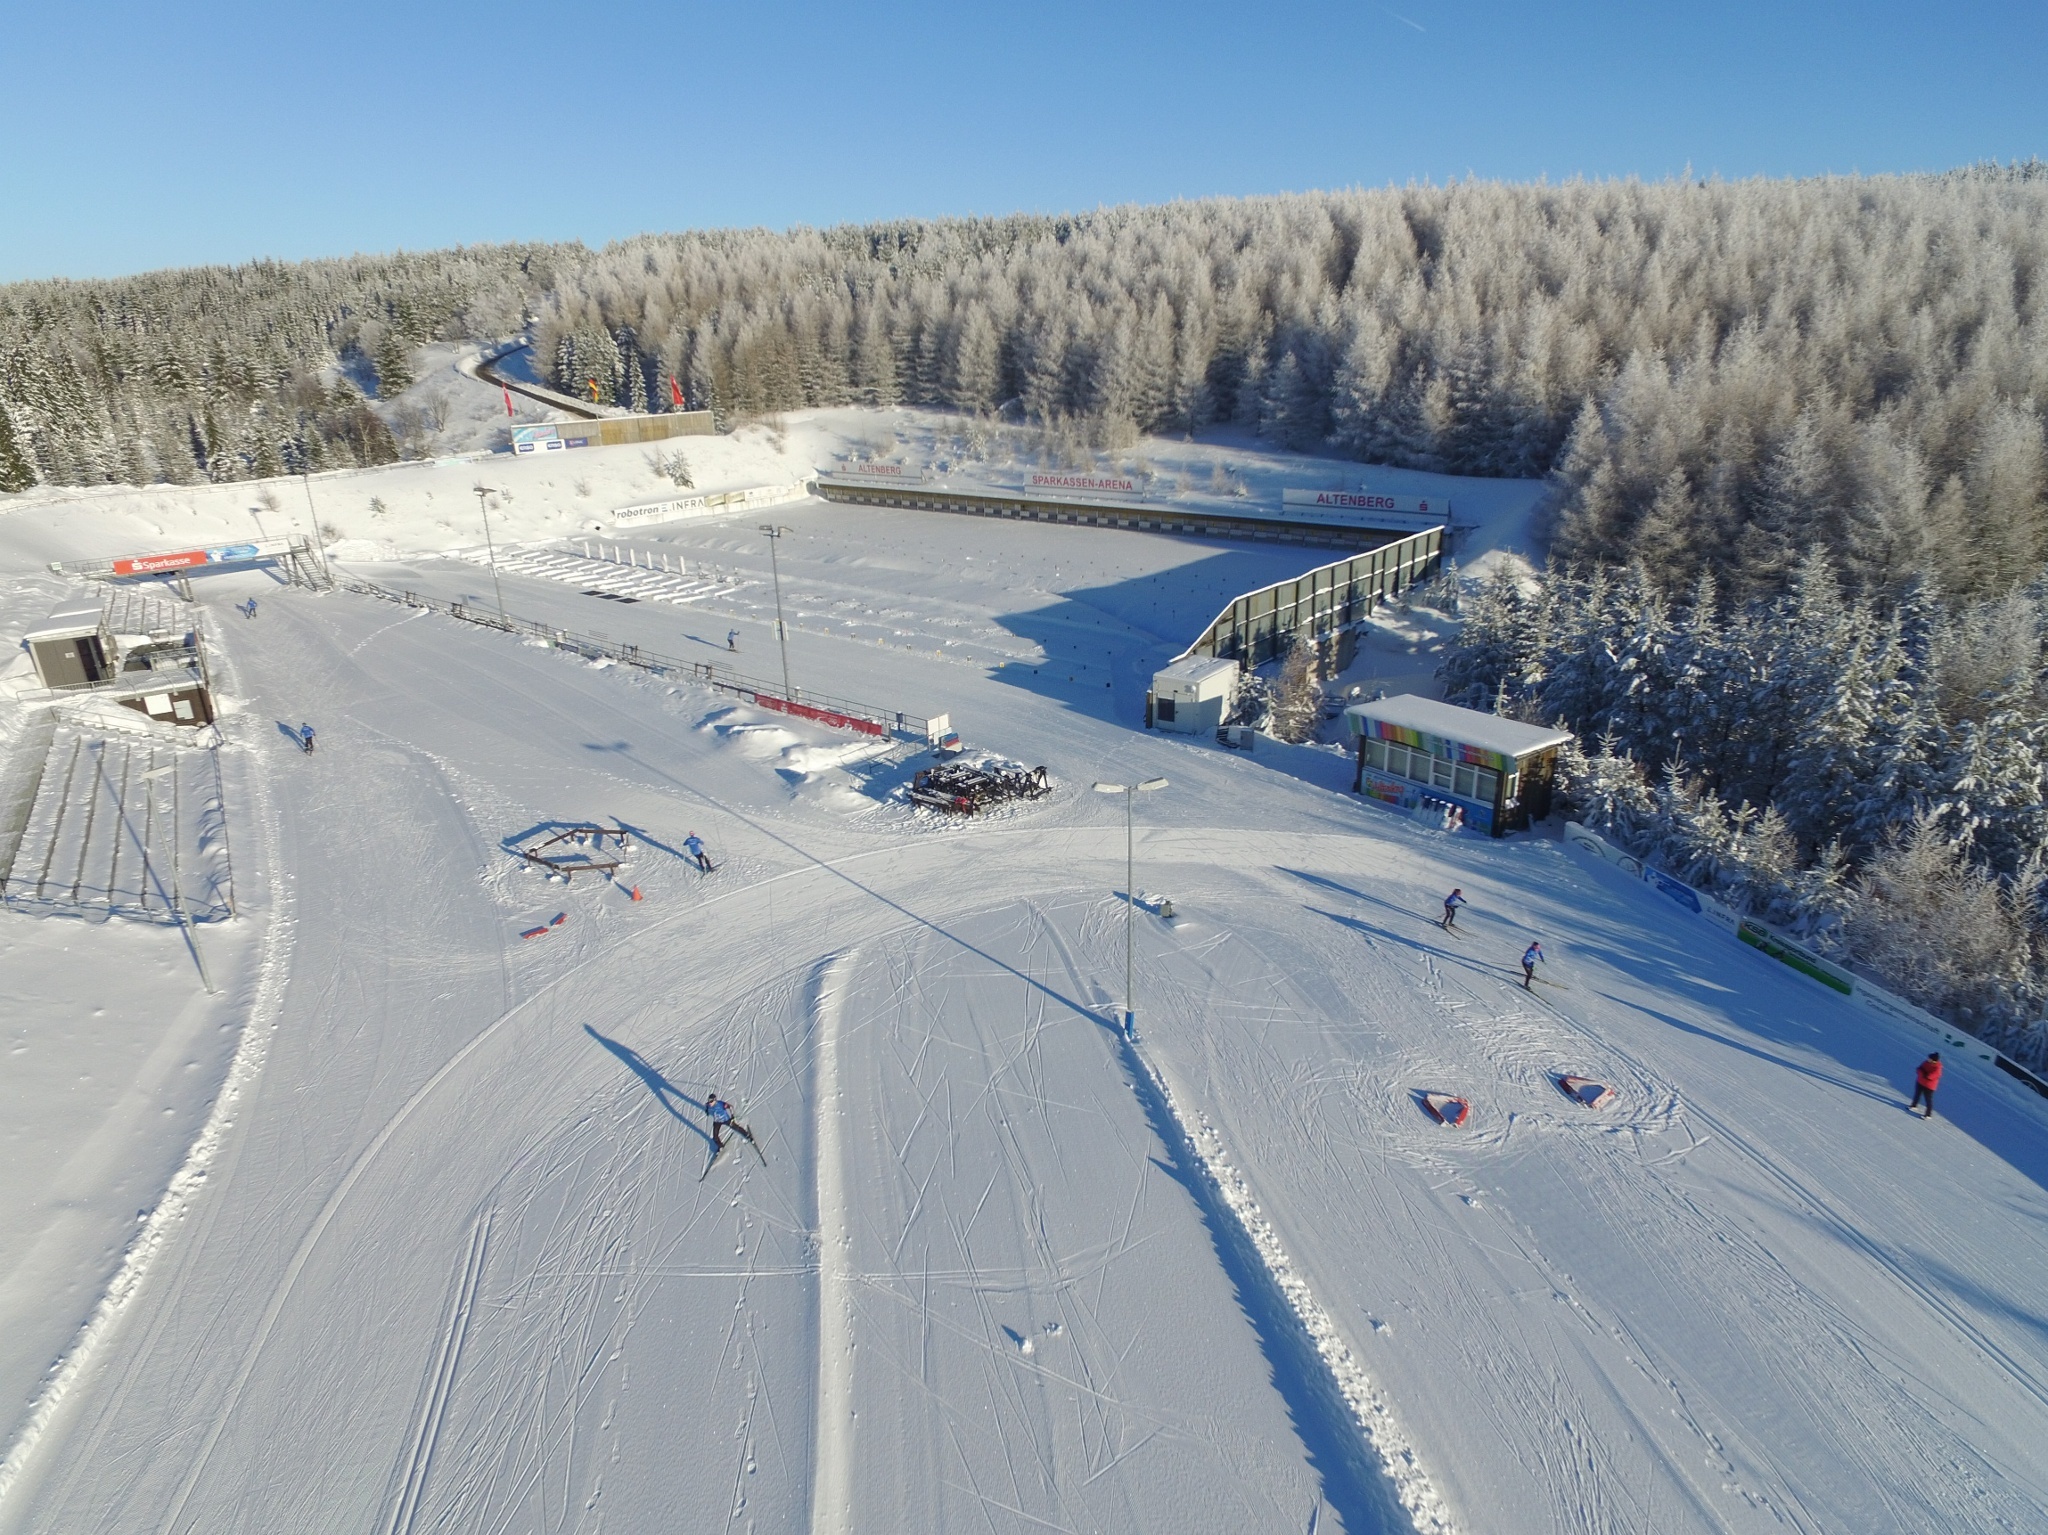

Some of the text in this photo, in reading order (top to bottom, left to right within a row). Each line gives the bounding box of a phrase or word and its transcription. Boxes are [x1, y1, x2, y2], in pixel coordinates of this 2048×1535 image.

[858, 464, 902, 475] ALTENBERG
[1032, 475, 1133, 490] SPARKASSEN-ARENA
[1316, 493, 1395, 509] ALTENBERG
[616, 506, 659, 519] robotron
[142, 557, 191, 570] Sparkasse
